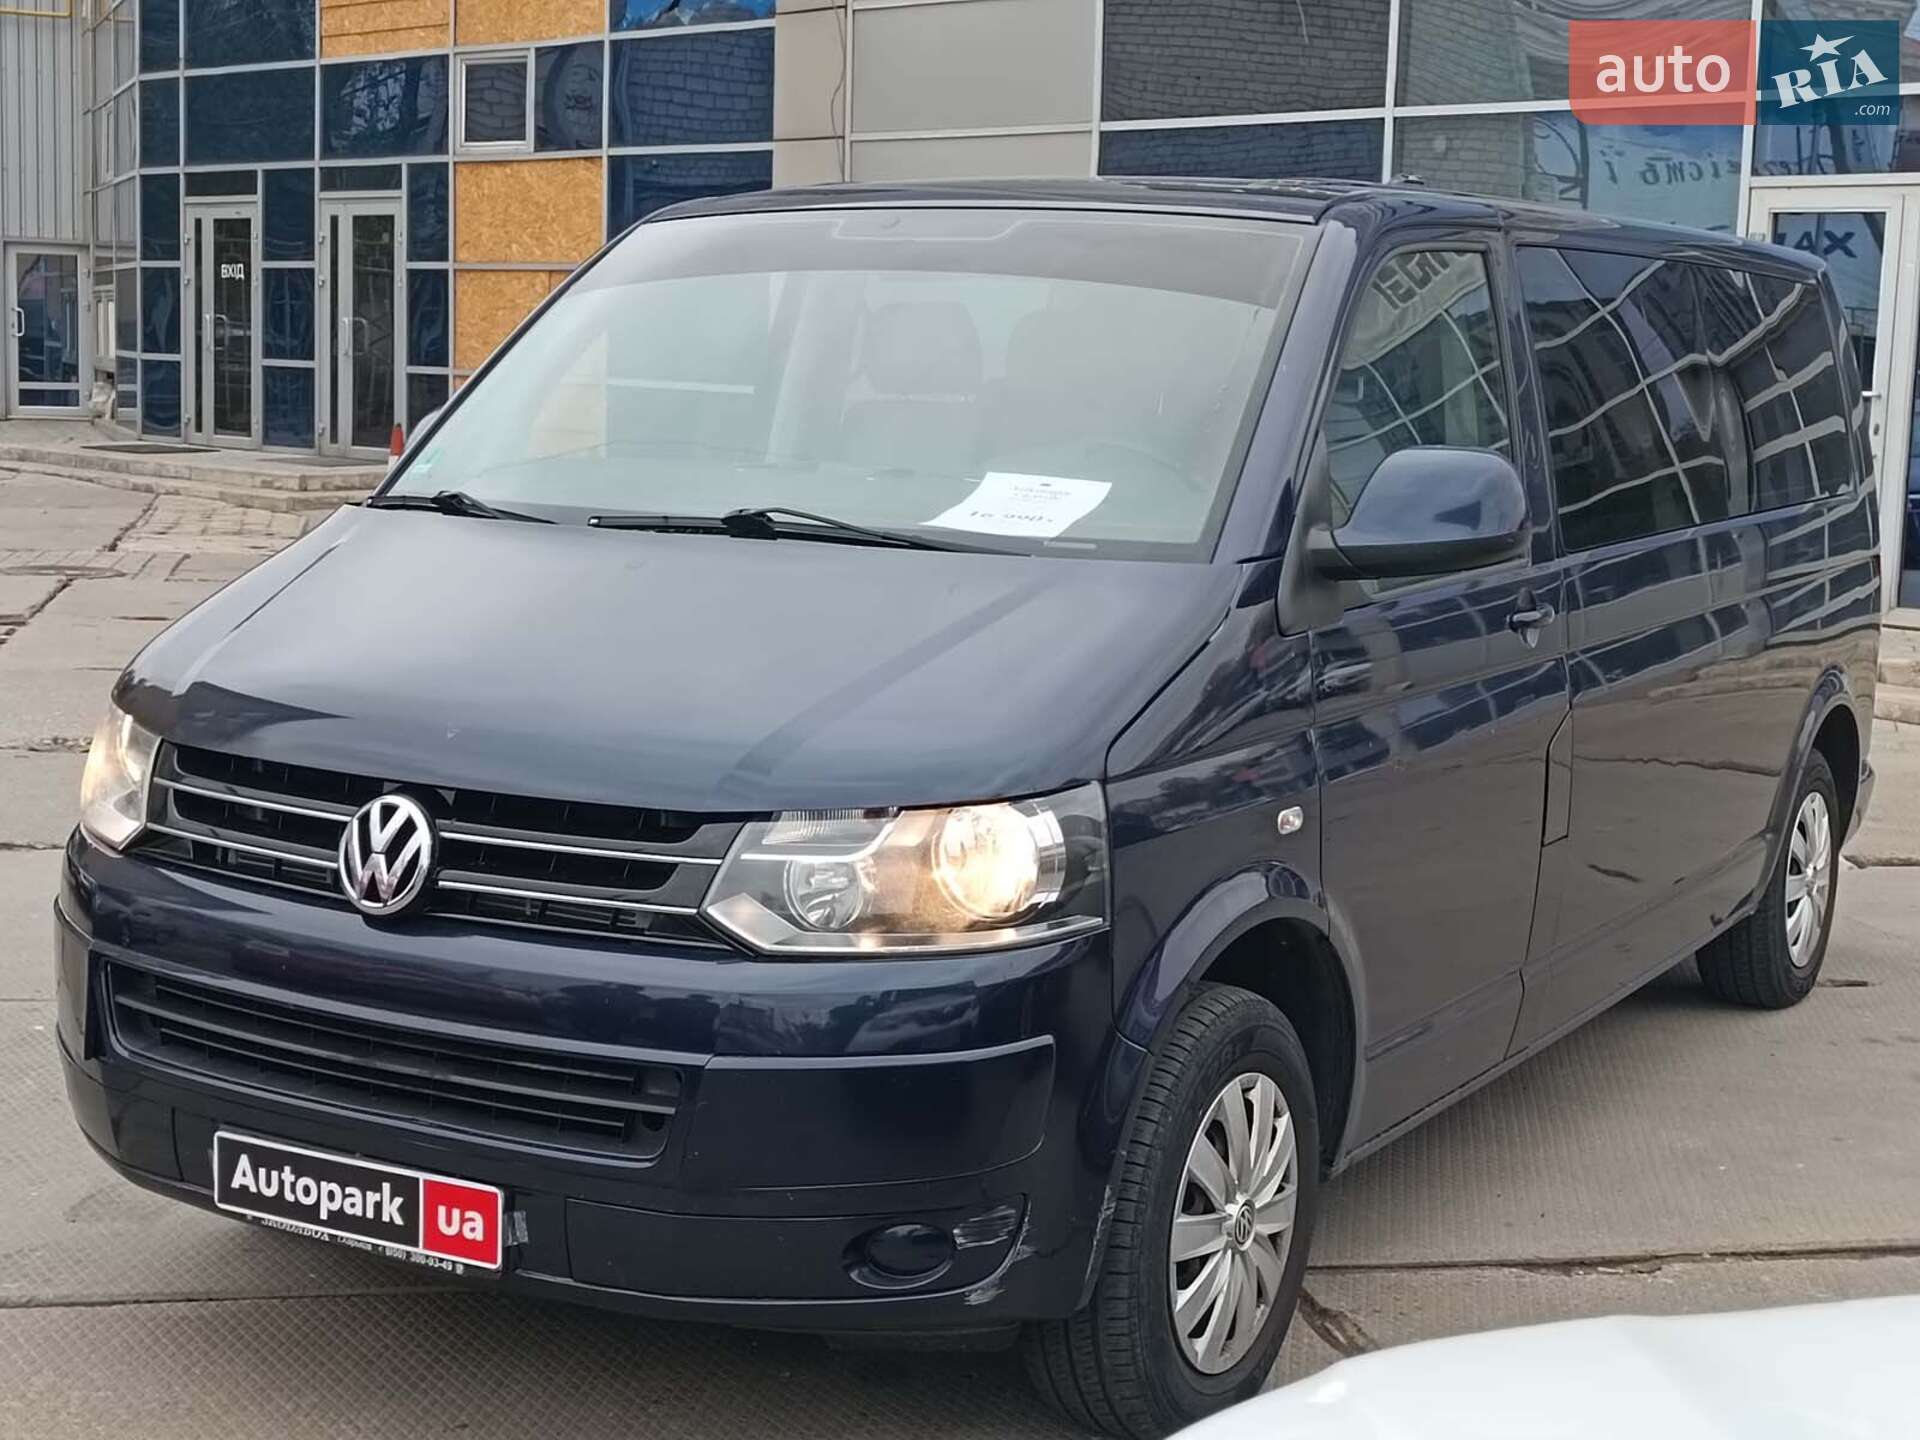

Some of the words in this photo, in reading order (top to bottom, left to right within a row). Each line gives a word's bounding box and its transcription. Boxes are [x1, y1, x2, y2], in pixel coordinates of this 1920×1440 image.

[221, 263, 245, 281] ВХІД
[230, 1153, 404, 1226] Autopark
[437, 1205, 484, 1241] ua
